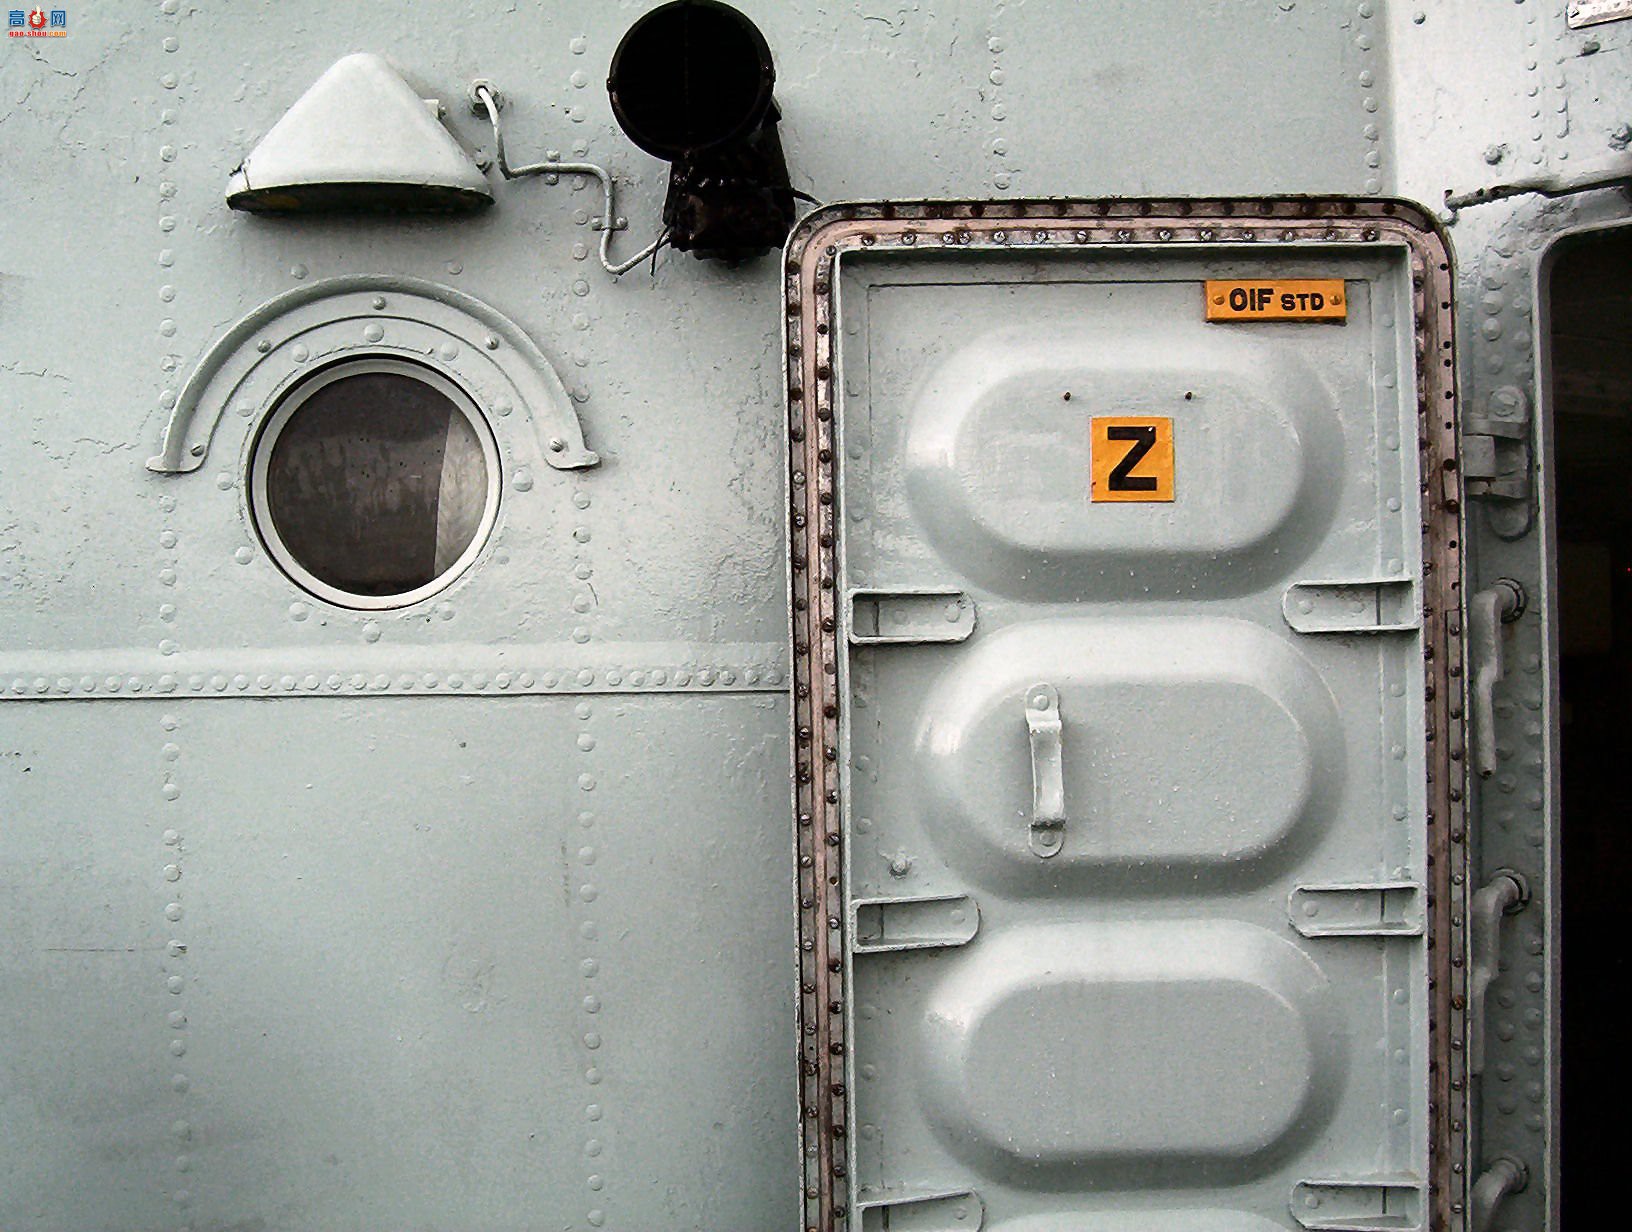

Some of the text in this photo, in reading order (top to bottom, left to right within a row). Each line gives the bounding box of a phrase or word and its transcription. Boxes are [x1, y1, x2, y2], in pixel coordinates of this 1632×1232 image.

[1229, 287, 1325, 311] OIF STD
[1107, 426, 1157, 491] Z
